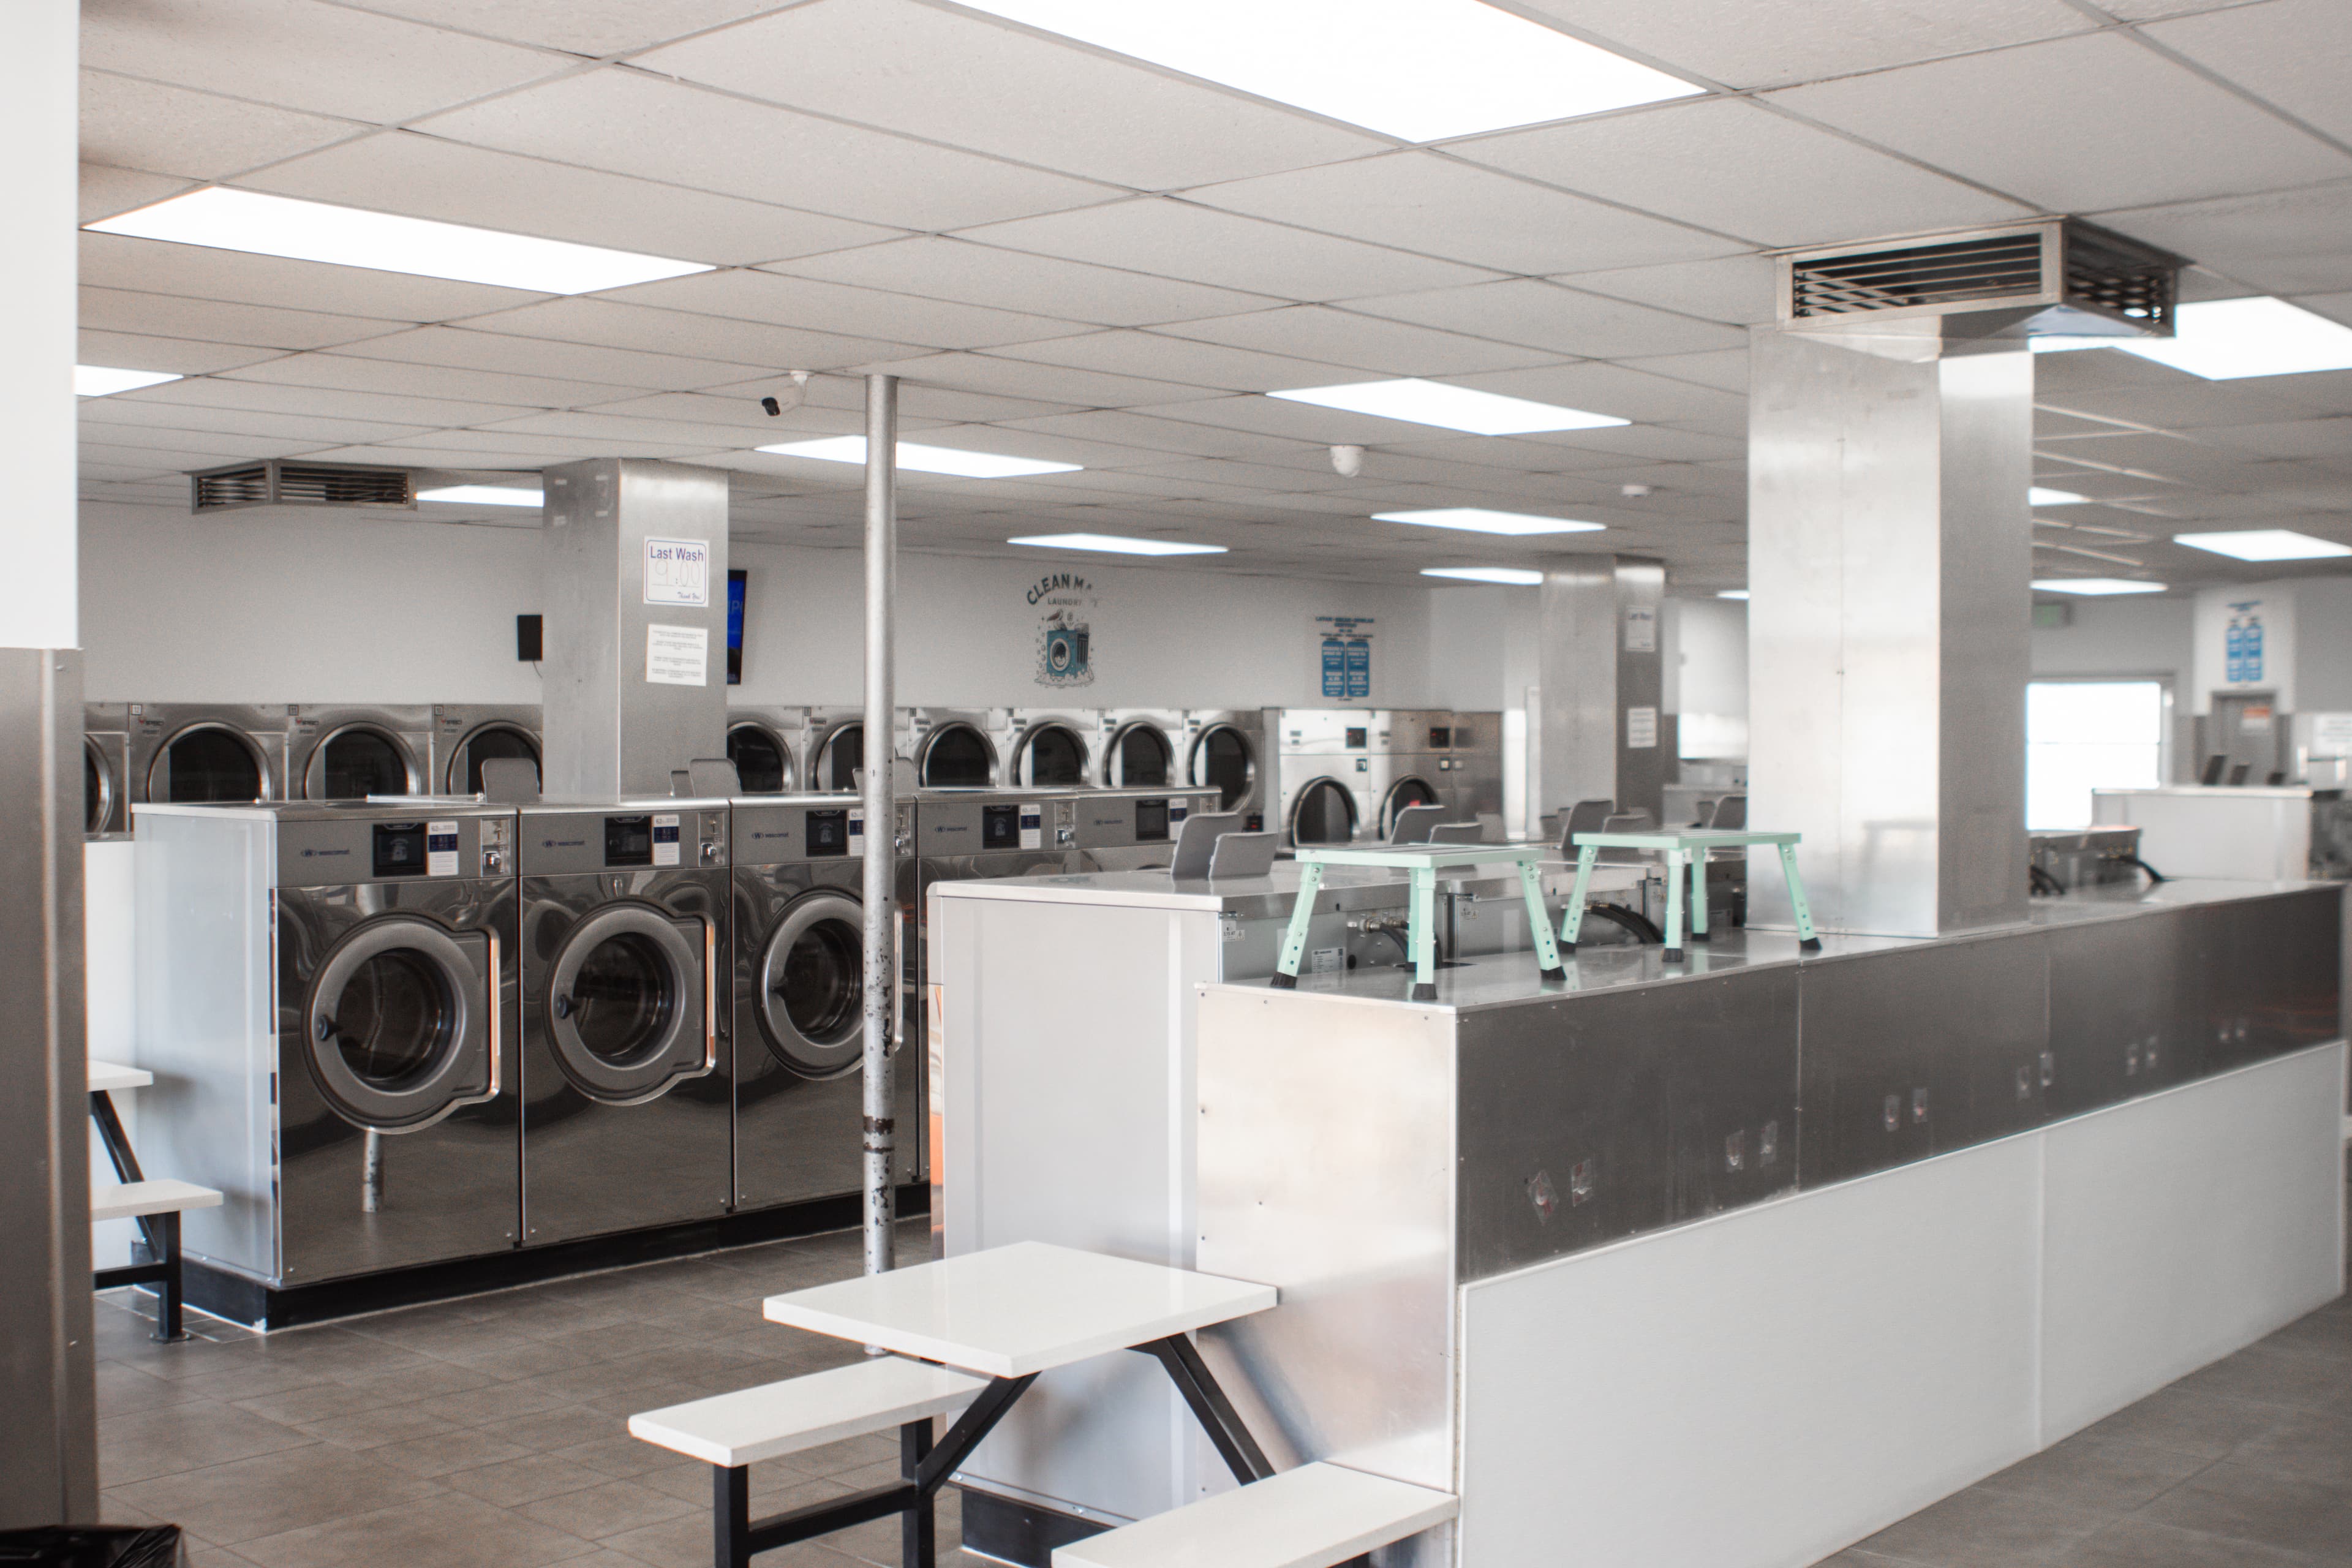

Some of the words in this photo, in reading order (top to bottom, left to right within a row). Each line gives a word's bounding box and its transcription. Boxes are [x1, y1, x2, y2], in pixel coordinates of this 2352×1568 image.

[650, 546, 672, 560] Last
[676, 548, 704, 562] Wash
[1027, 573, 1070, 605] CLEAN
